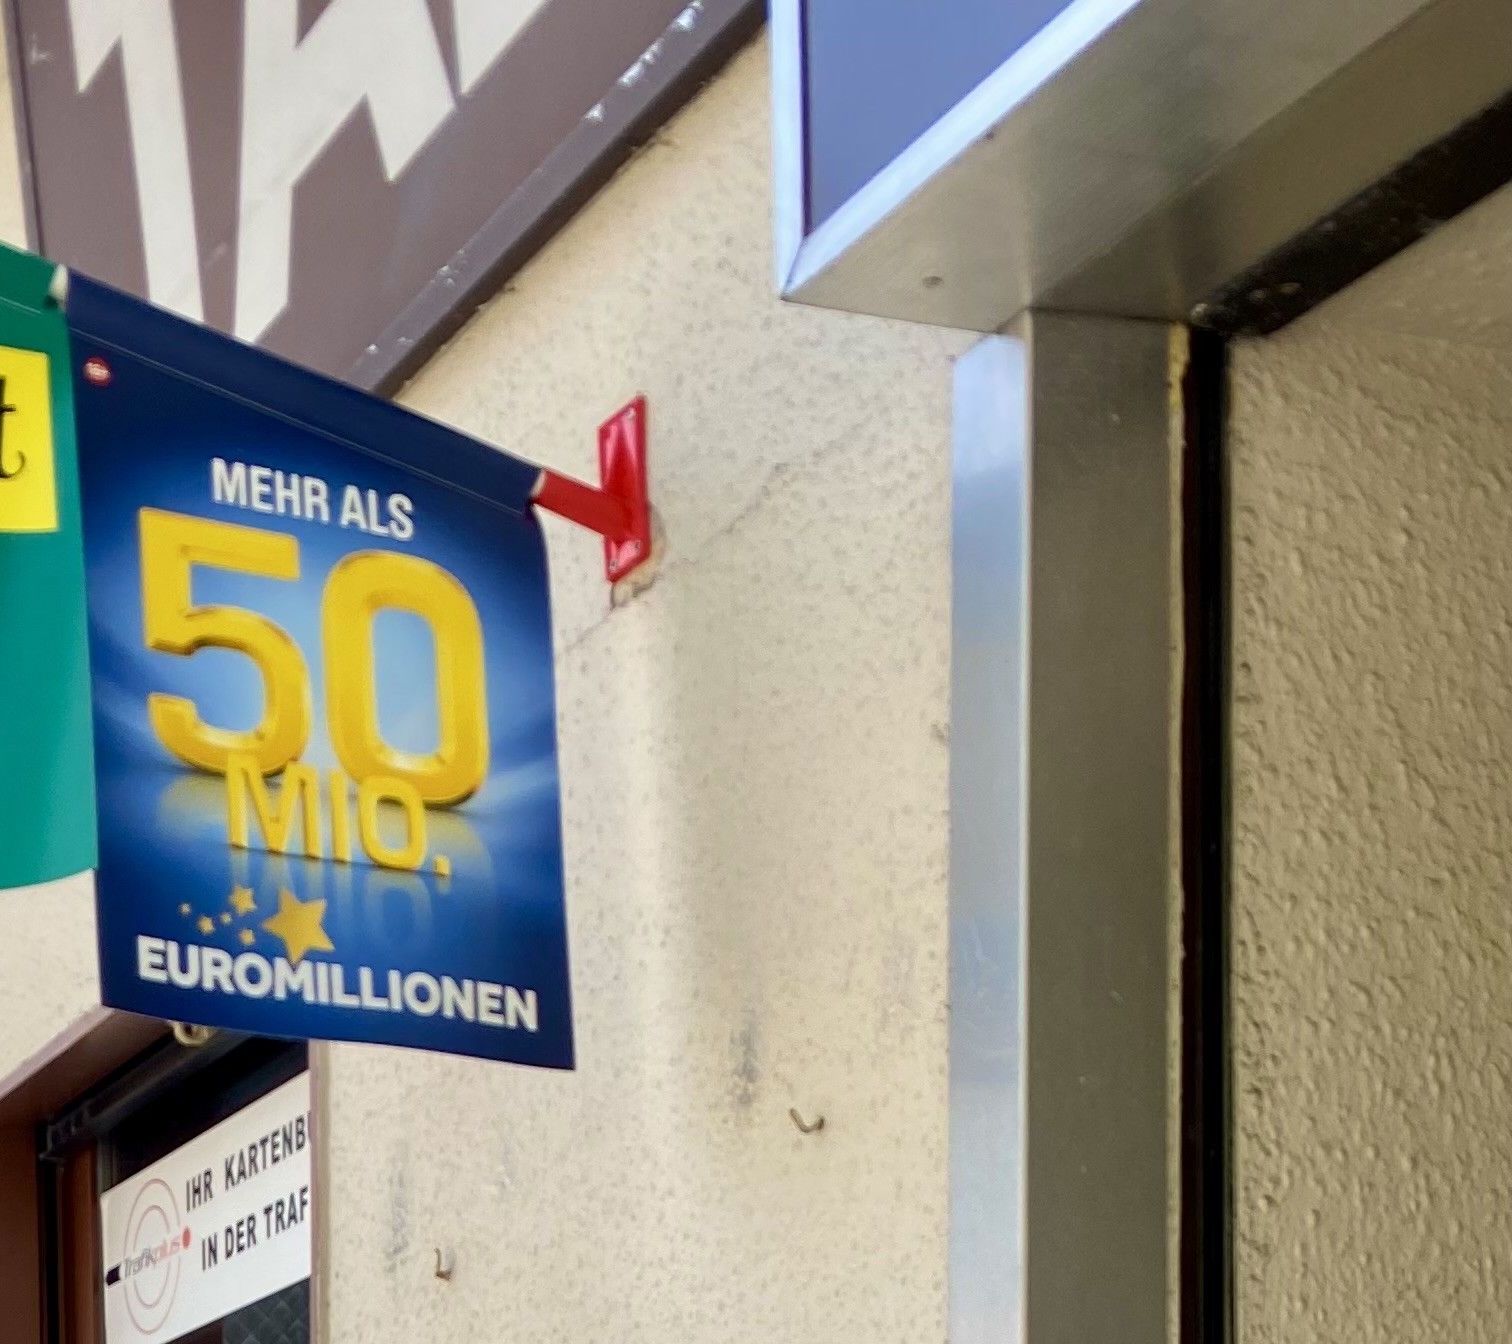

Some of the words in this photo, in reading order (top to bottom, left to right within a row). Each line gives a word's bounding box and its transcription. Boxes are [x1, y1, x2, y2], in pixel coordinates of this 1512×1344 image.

[66, 0, 554, 343] TA
[211, 457, 329, 524] MEHR
[340, 485, 414, 541] ALS
[138, 506, 490, 807] 50
[136, 936, 538, 1033] EUROMILLIONEN
[186, 1168, 213, 1213] IHR
[224, 1111, 311, 1191] KARTENB
[201, 1232, 219, 1271] IN
[224, 1219, 256, 1260] DER
[264, 1187, 308, 1240] TRAF
